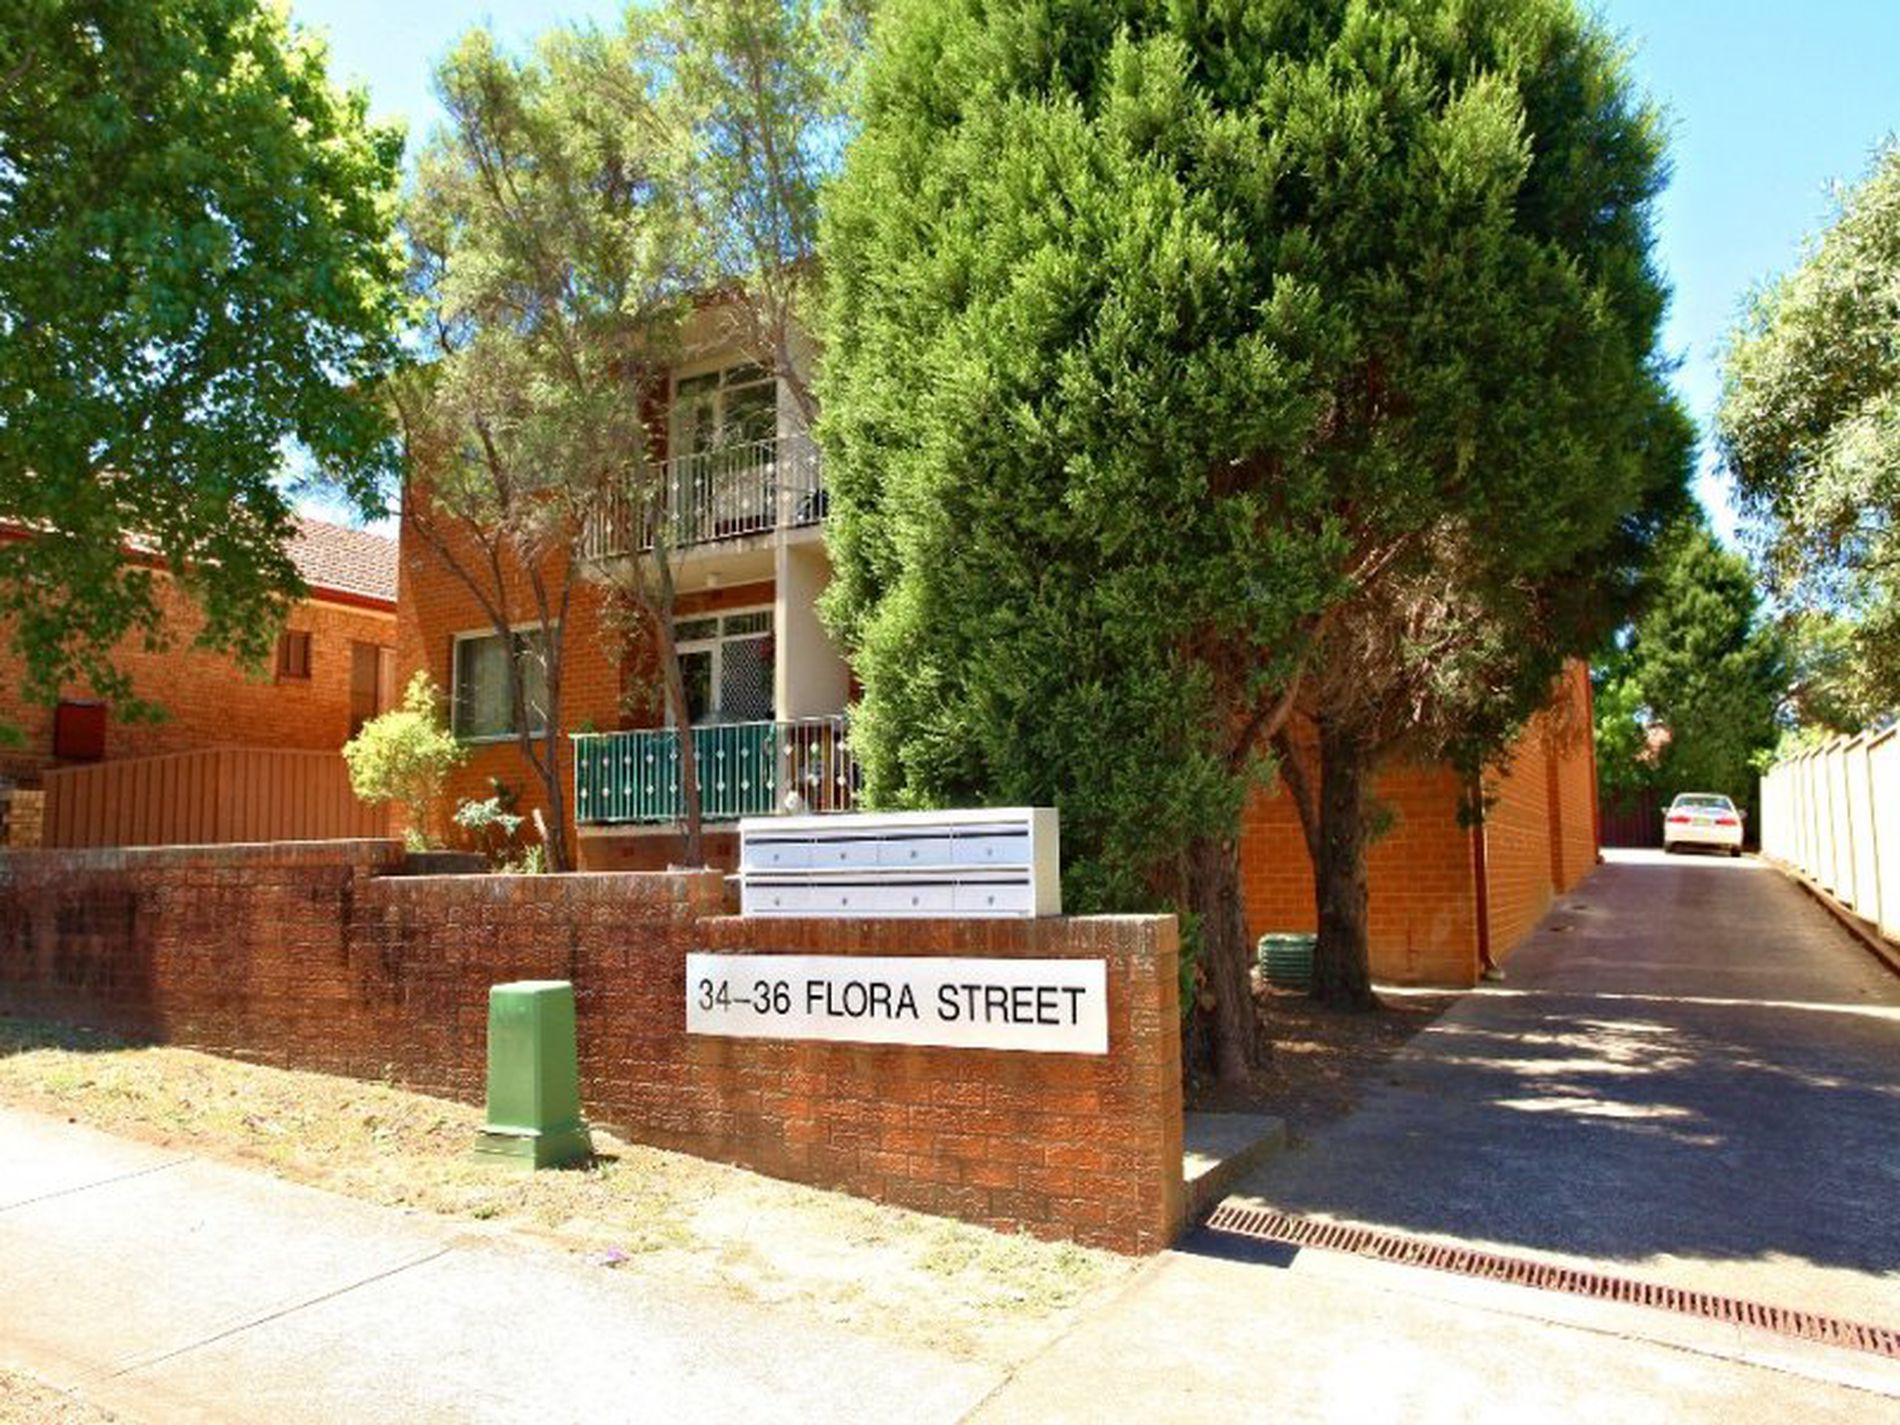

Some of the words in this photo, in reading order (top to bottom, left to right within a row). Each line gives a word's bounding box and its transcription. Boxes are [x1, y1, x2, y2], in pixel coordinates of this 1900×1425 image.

[698, 978, 792, 1015] 34-36
[806, 980, 919, 1019] FLORA
[937, 984, 1086, 1025] STREET
